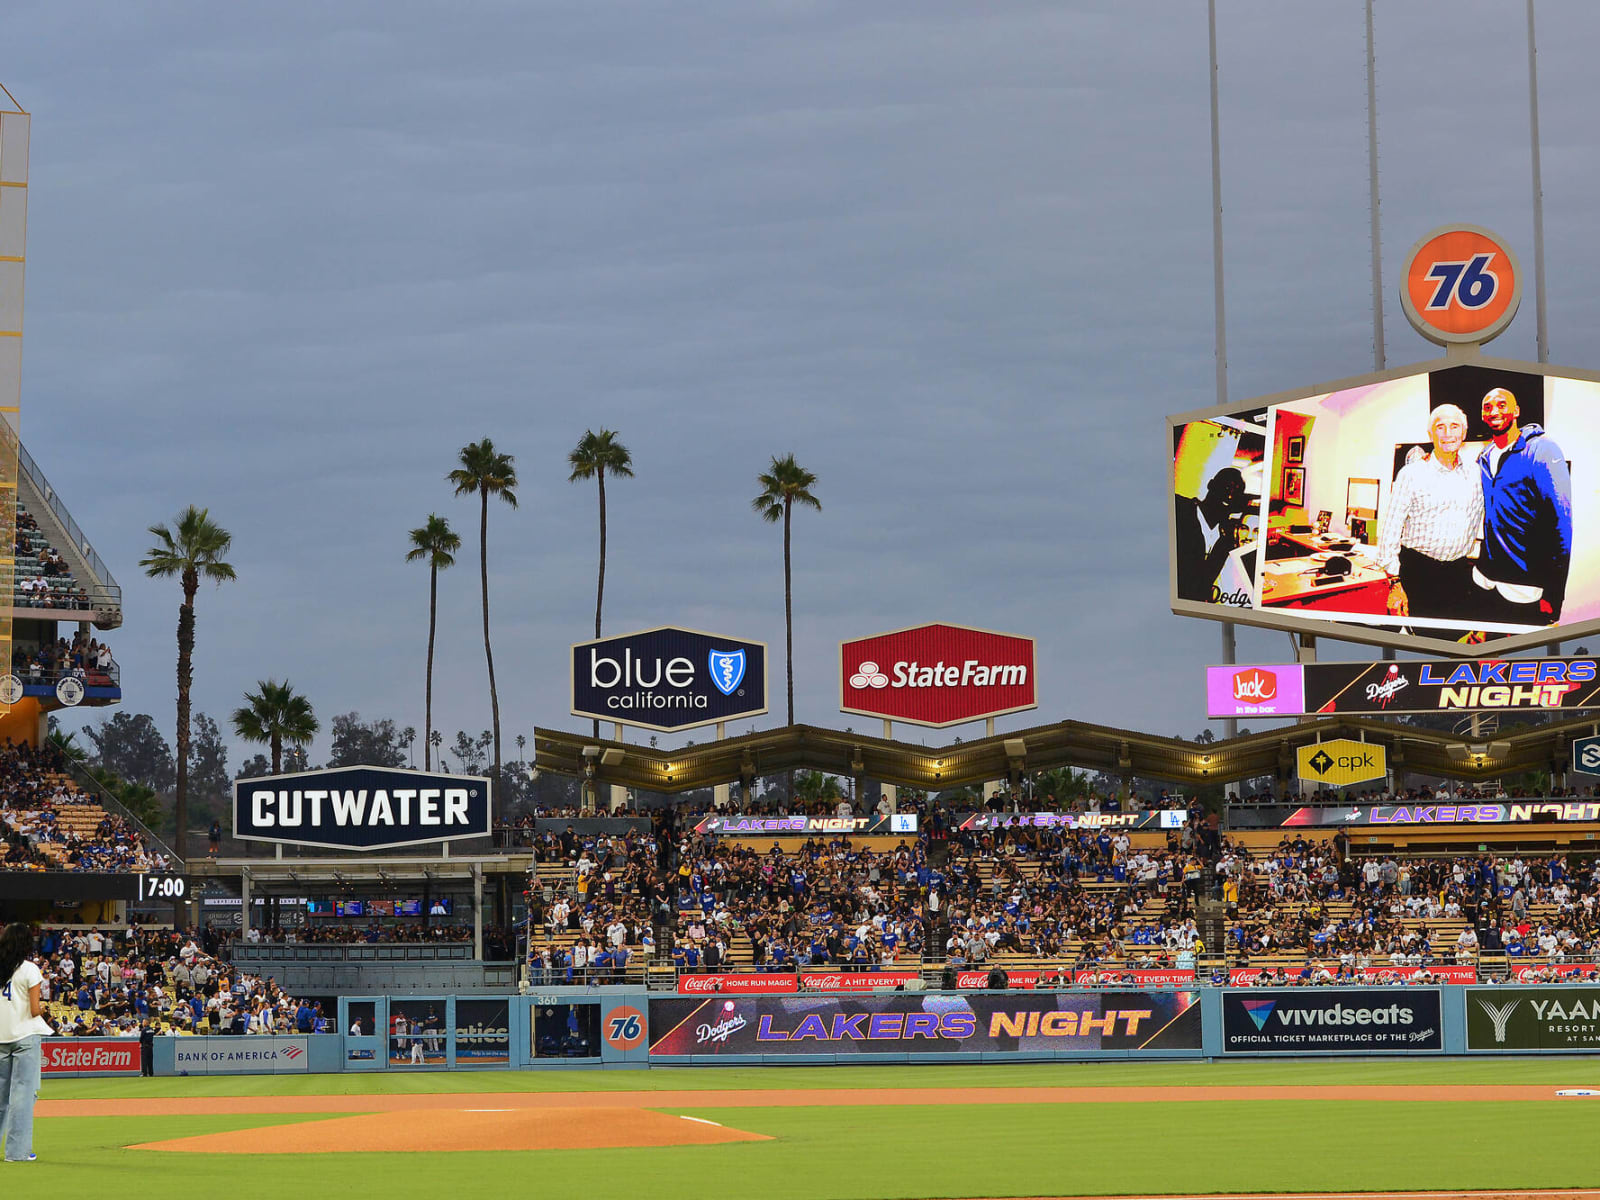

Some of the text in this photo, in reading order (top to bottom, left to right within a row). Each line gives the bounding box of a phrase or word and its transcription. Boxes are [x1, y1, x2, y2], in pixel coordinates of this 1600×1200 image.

[1424, 252, 1499, 311] 76
[1212, 585, 1252, 609] Dodg
[591, 647, 695, 688] blue
[1419, 661, 1597, 685] LAKERS
[1234, 672, 1275, 699] Jack
[1366, 675, 1409, 700] Dodgers
[1438, 684, 1570, 708] NIGHT
[607, 691, 708, 709] california
[1338, 752, 1374, 772] cpk
[252, 789, 470, 827] CUTWATER
[1370, 806, 1500, 823] LAKERS
[723, 819, 805, 830] LAKERS
[808, 818, 870, 829] NIGHT
[1078, 815, 1138, 826] NIGHT
[148, 878, 184, 897] 7:00
[959, 974, 988, 988] Coca-Co
[538, 996, 557, 1005] 360
[1277, 1003, 1414, 1025] vividseats
[411, 1022, 508, 1043] natics
[609, 1015, 642, 1040] 76
[696, 1013, 747, 1043] Dodgers
[756, 1010, 1152, 1041] LAKERS NIGHT
[1231, 1035, 1271, 1043] OFFICIAL
[1309, 1034, 1372, 1042] MARKETPLACE
[1391, 1033, 1406, 1041] THE
[1409, 1028, 1435, 1042] Dodgers
[210, 1052, 225, 1060] OF
[227, 1051, 278, 1060] AMERICA
